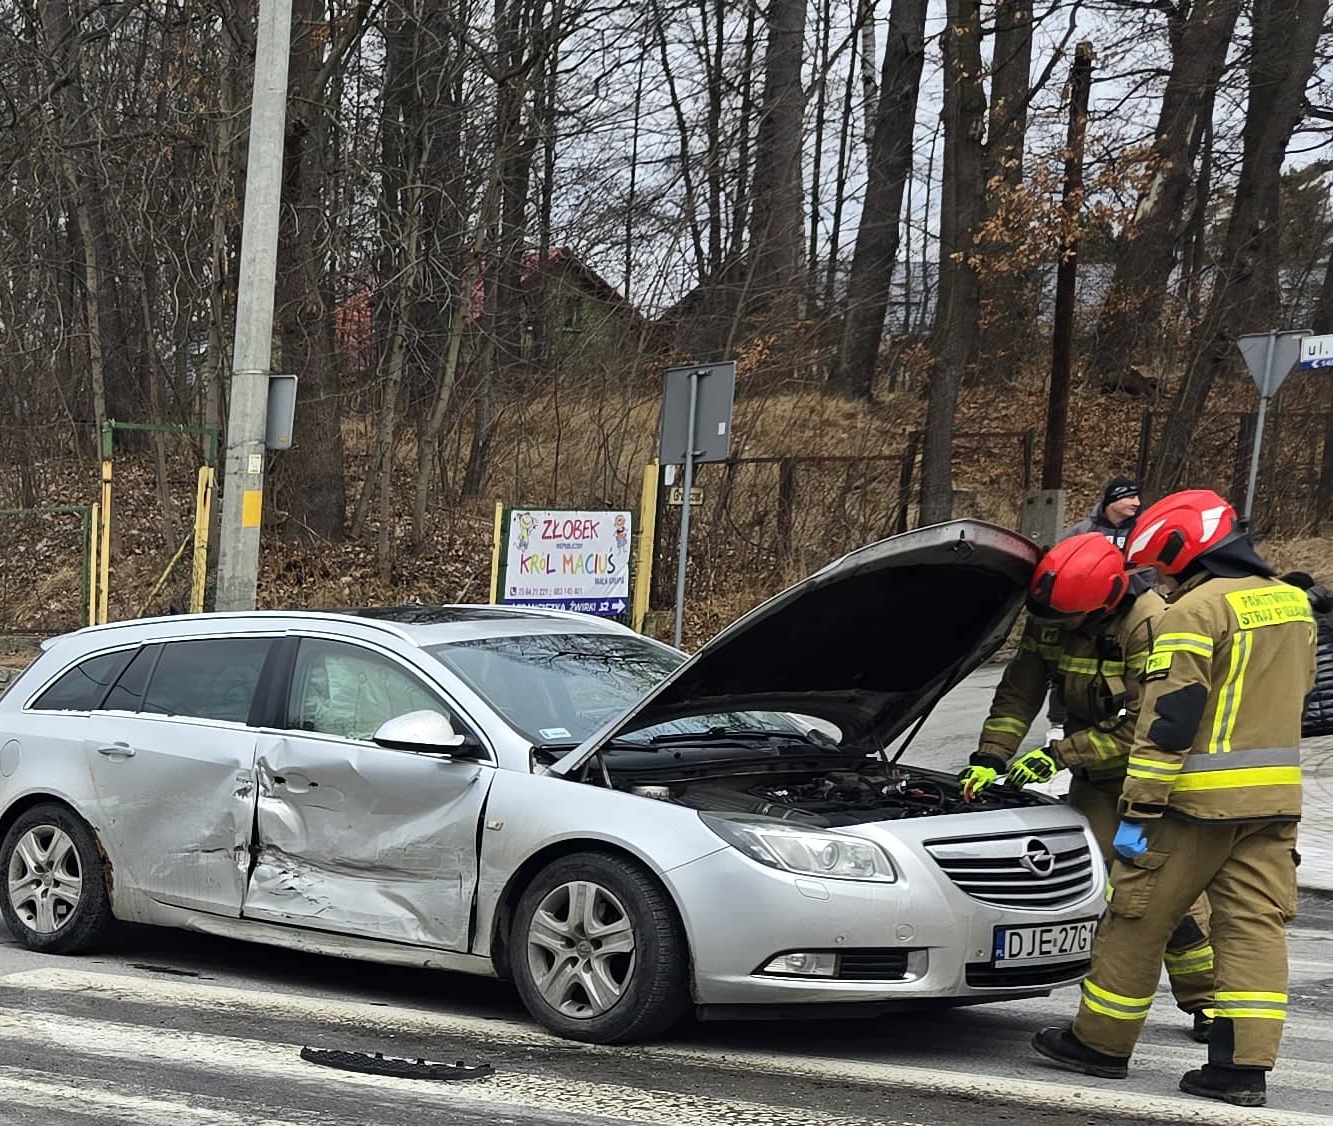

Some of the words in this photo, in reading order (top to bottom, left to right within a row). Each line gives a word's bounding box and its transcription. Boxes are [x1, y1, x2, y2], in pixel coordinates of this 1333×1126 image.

[1308, 341, 1329, 356] ul.
[541, 513, 600, 540] ŻŁOBEK
[520, 552, 556, 575] KRÓL
[562, 547, 616, 574] MACIUŚ
[1008, 928, 1053, 958] DJE
